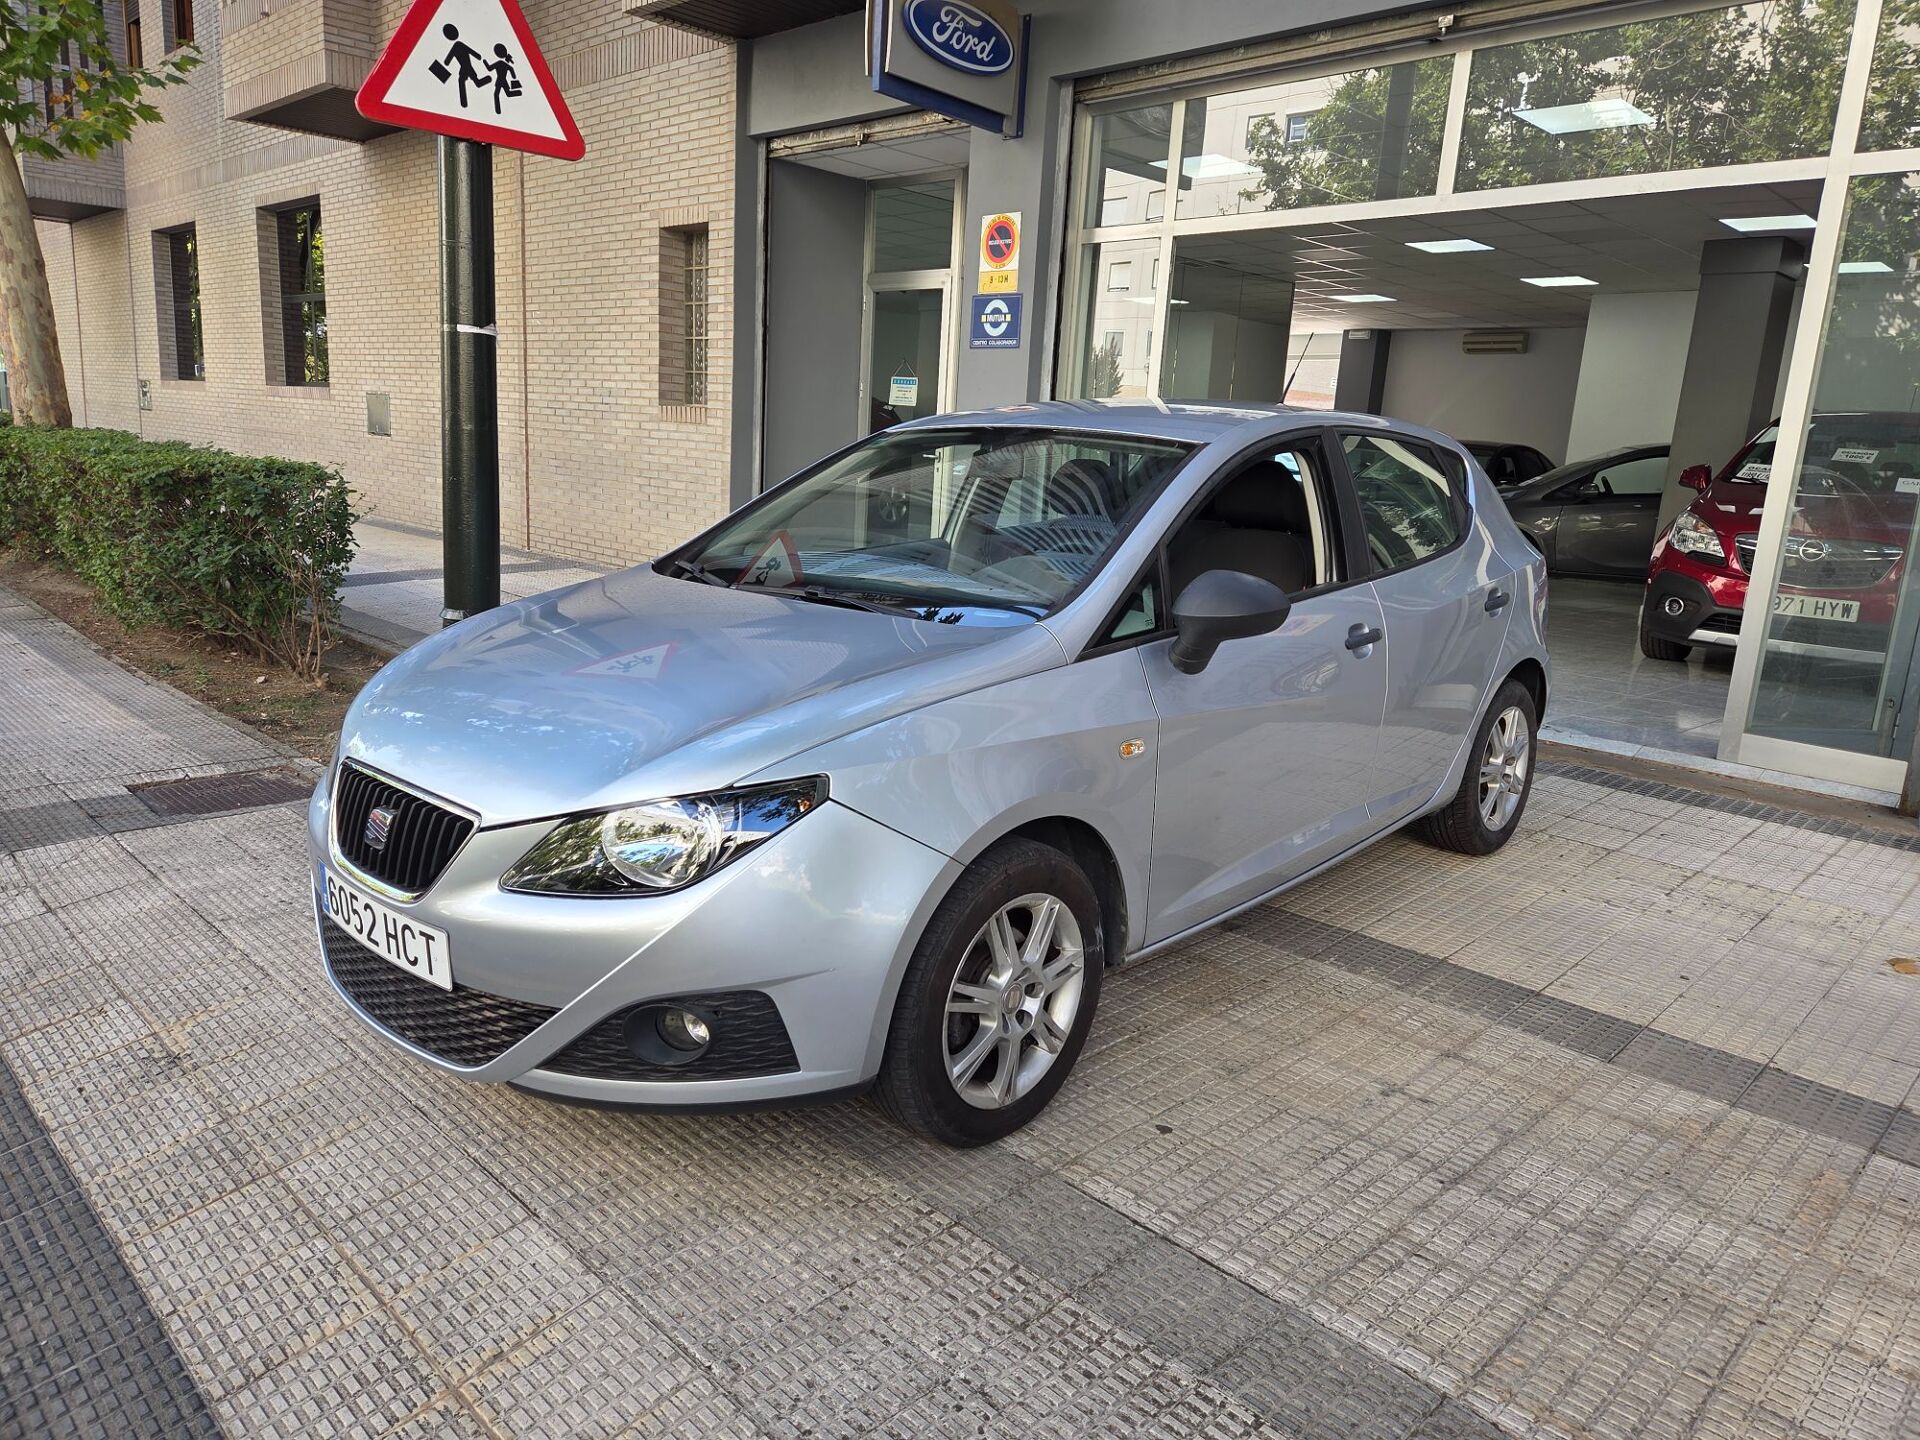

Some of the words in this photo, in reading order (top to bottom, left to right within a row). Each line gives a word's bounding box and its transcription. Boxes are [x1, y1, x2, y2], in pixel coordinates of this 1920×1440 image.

[932, 5, 996, 61] Ford
[986, 314, 1005, 323] MUTUA
[1773, 595, 1805, 614] 971
[1813, 600, 1853, 619] HYW
[328, 875, 379, 947] 6052
[383, 912, 435, 976] HCT
